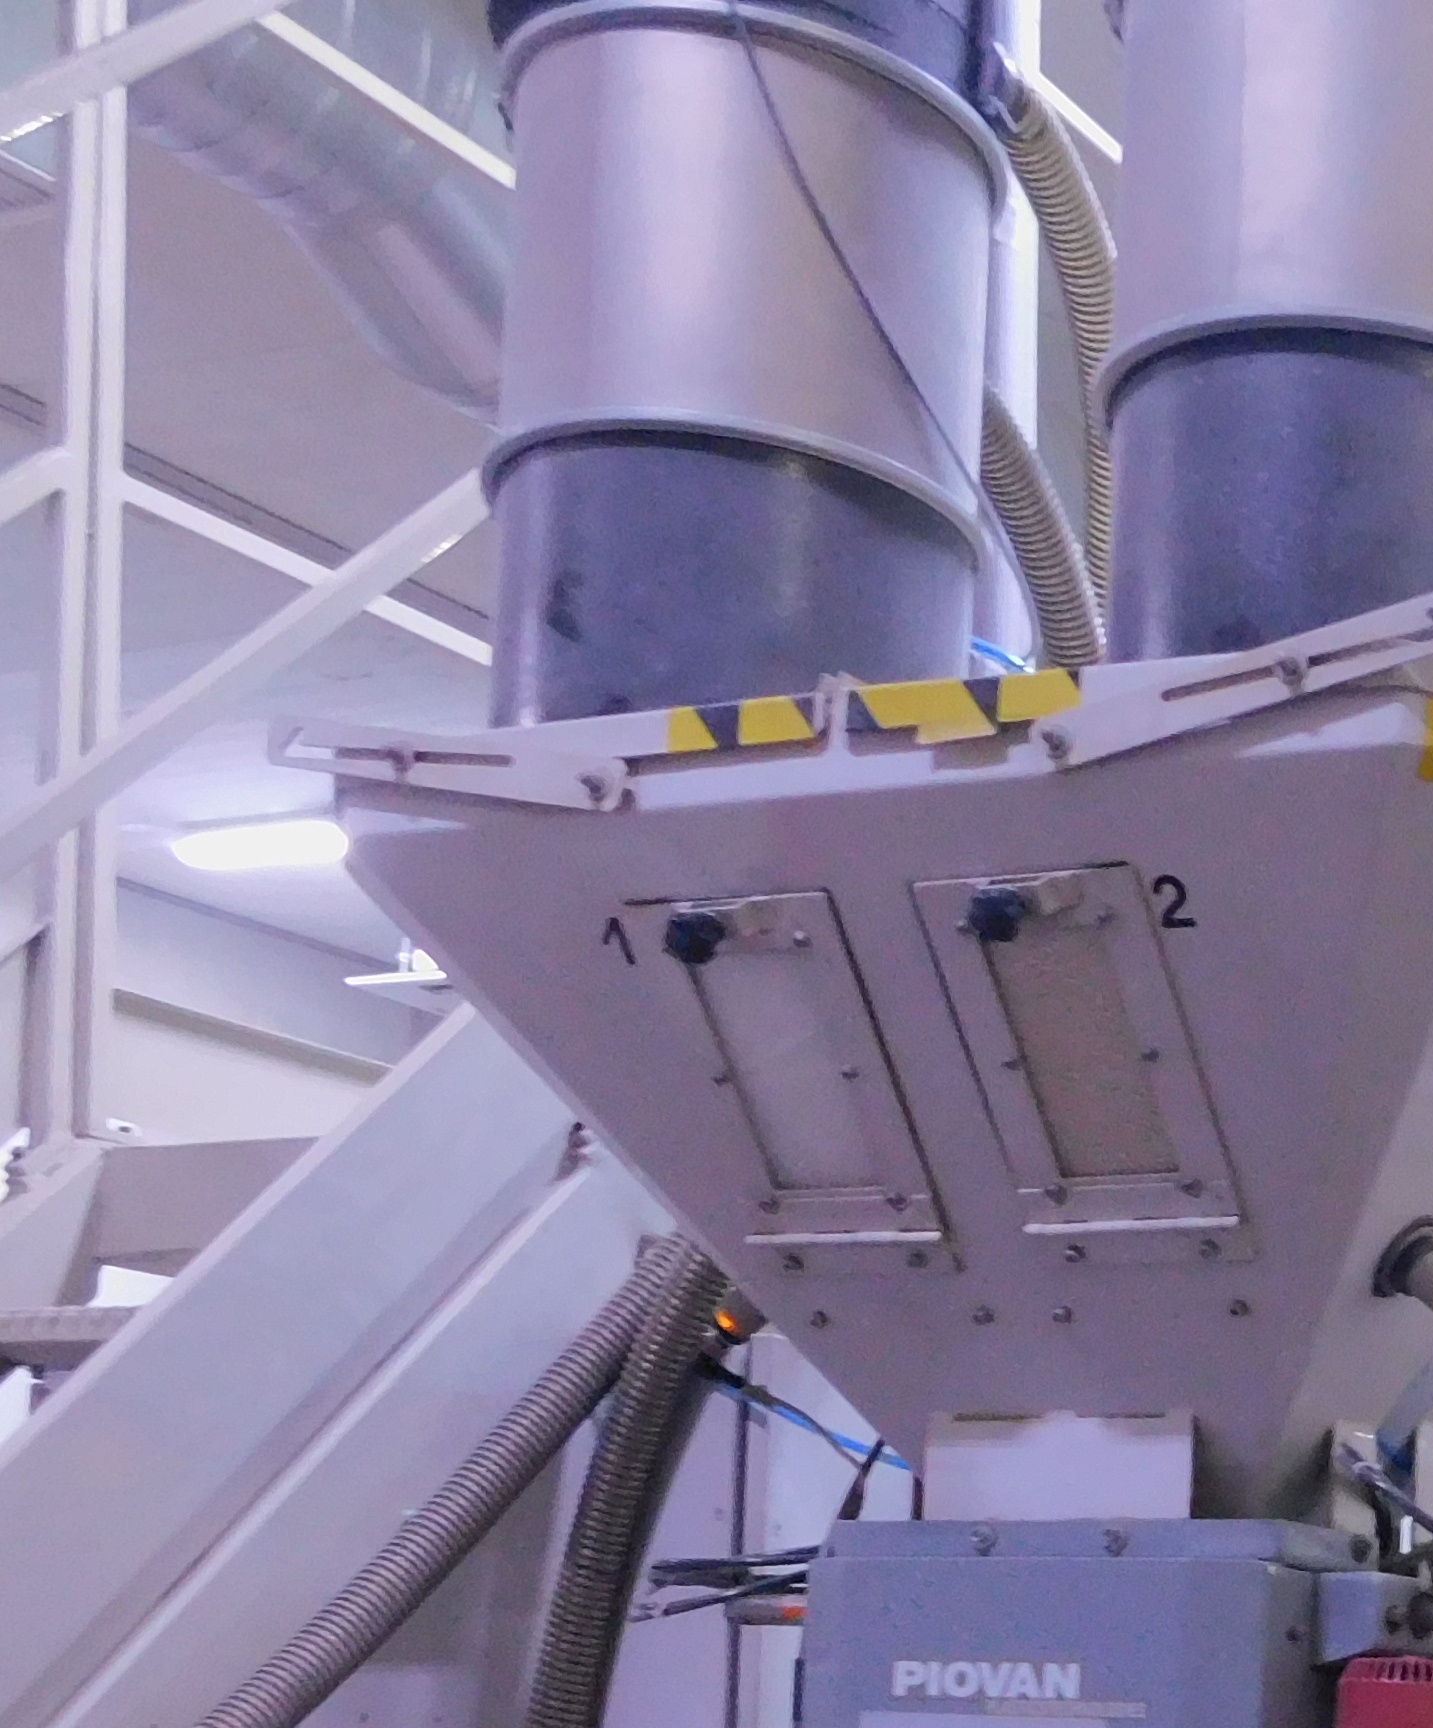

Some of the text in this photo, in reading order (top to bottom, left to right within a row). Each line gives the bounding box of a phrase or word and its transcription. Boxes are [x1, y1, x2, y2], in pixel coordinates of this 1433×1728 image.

[1152, 874, 1197, 929] 2
[602, 917, 636, 966] 1
[891, 1660, 1081, 1699] PIOVAN
